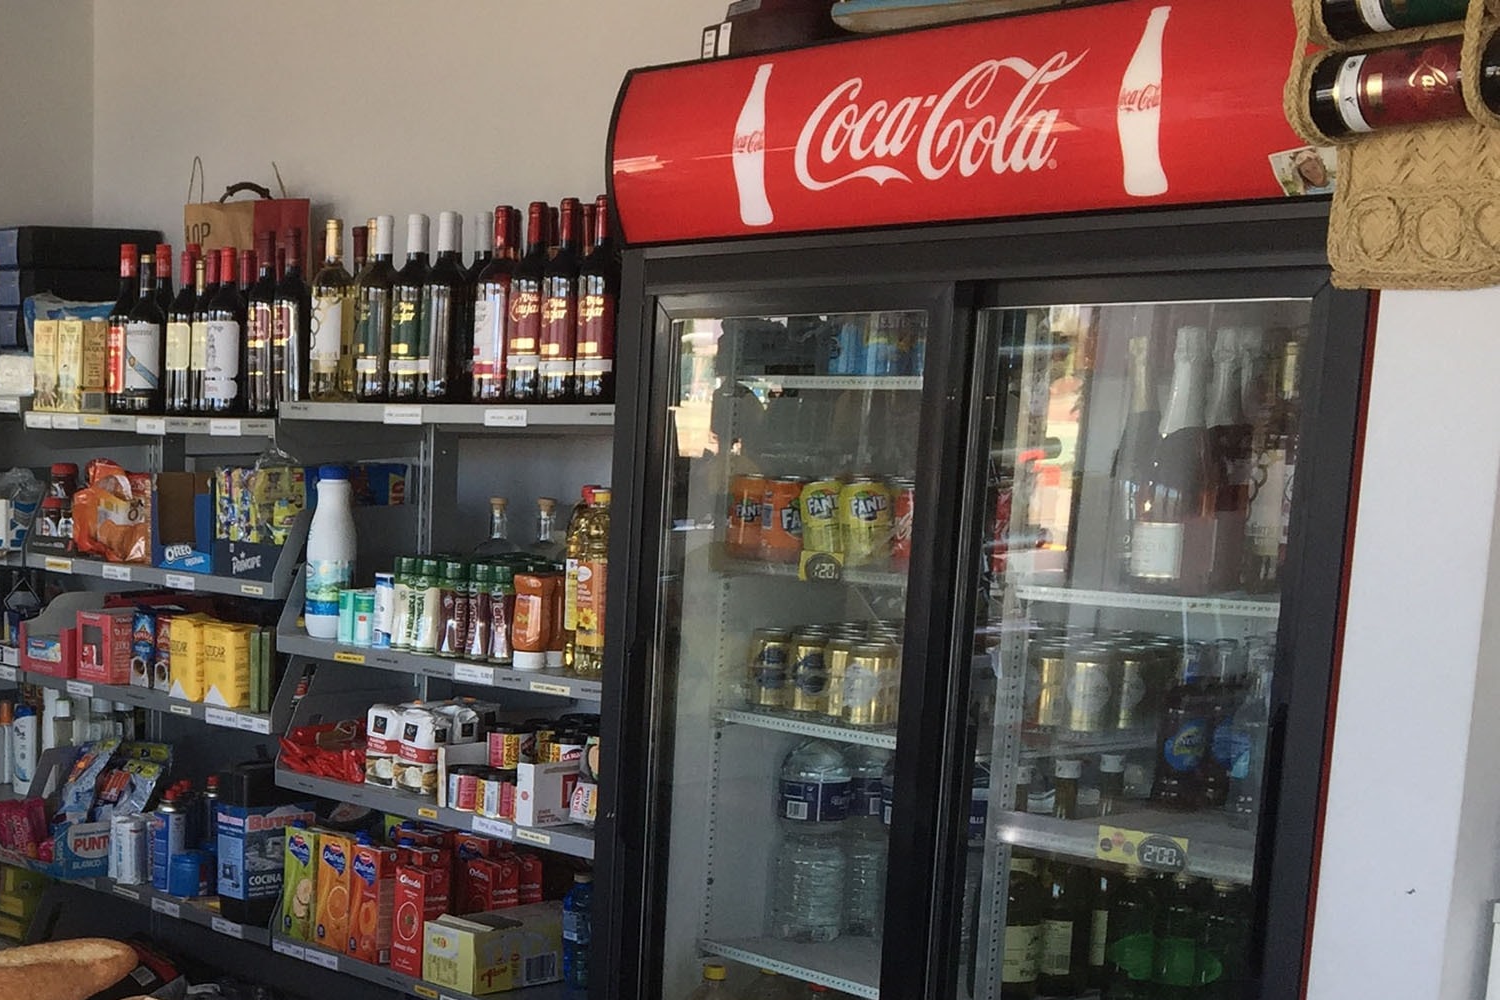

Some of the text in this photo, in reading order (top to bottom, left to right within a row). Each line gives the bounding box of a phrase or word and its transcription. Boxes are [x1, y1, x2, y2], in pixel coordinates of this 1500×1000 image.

[794, 47, 1091, 191] Coca-Cola
[807, 494, 838, 514] FANT
[164, 545, 192, 562] OREO
[74, 834, 110, 852] PUNT
[249, 874, 282, 886] COCINA
